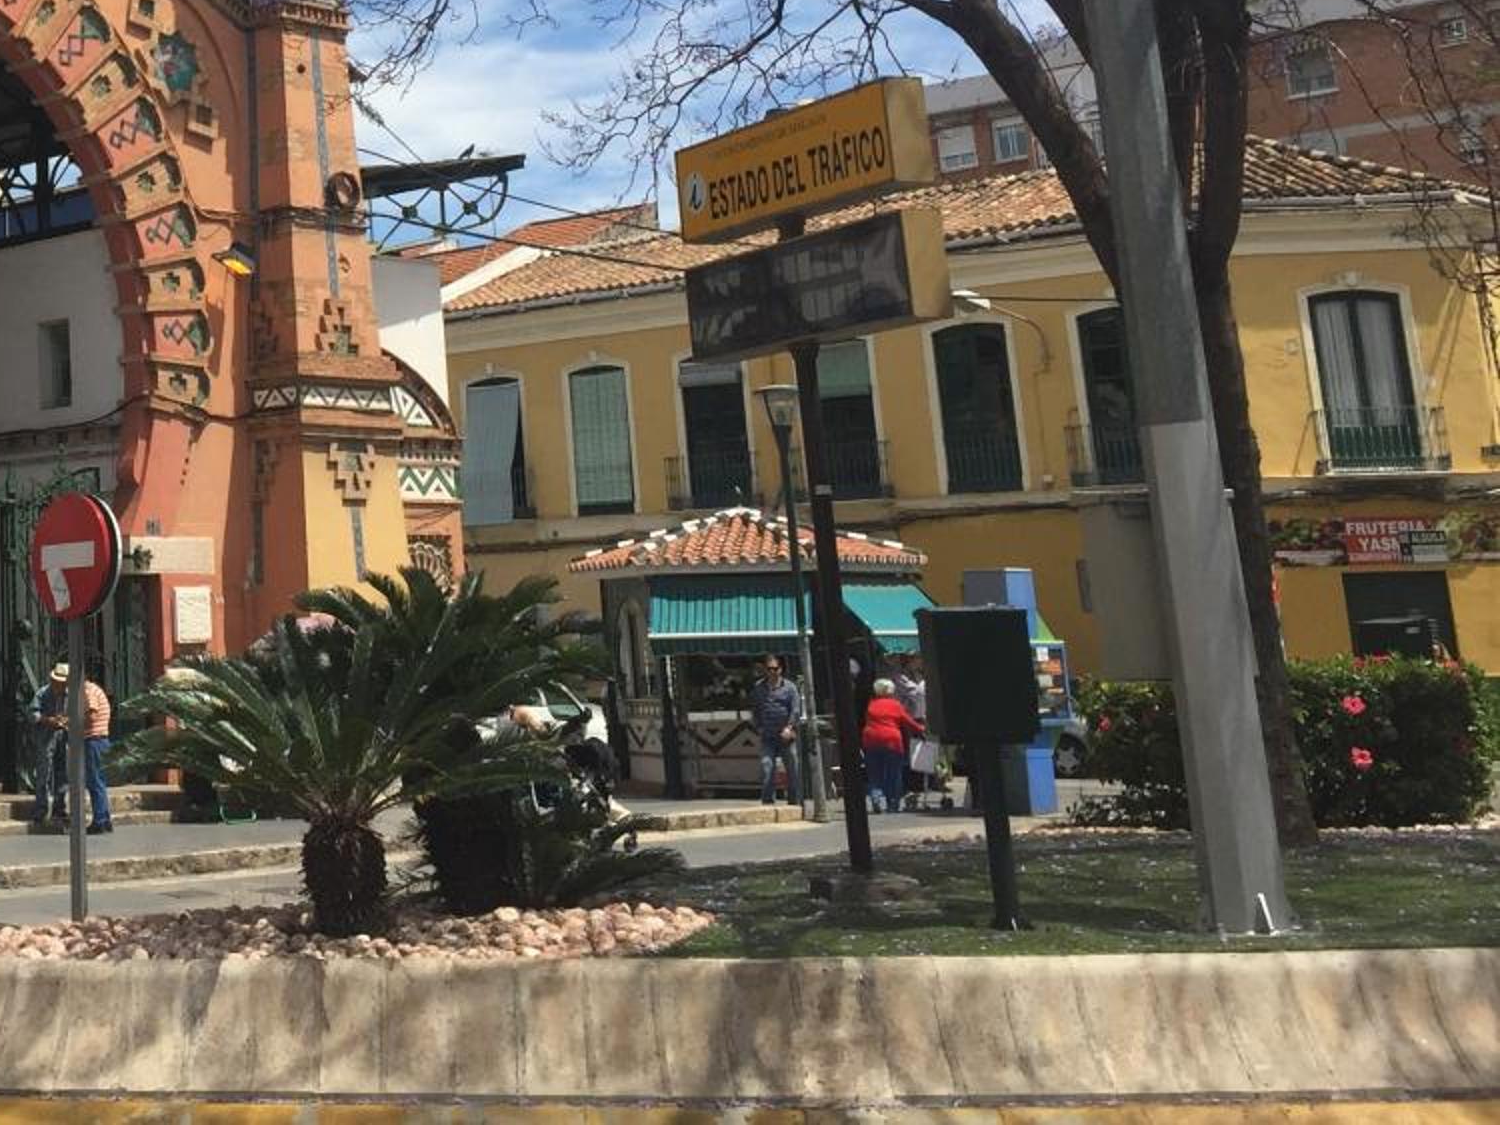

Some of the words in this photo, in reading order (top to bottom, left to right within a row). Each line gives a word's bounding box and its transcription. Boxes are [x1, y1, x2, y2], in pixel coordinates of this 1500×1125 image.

[709, 167, 769, 219] ESTADO
[772, 154, 806, 199] DEL
[807, 126, 886, 188] TRÁFICO
[1346, 520, 1426, 535] FRUTERIA
